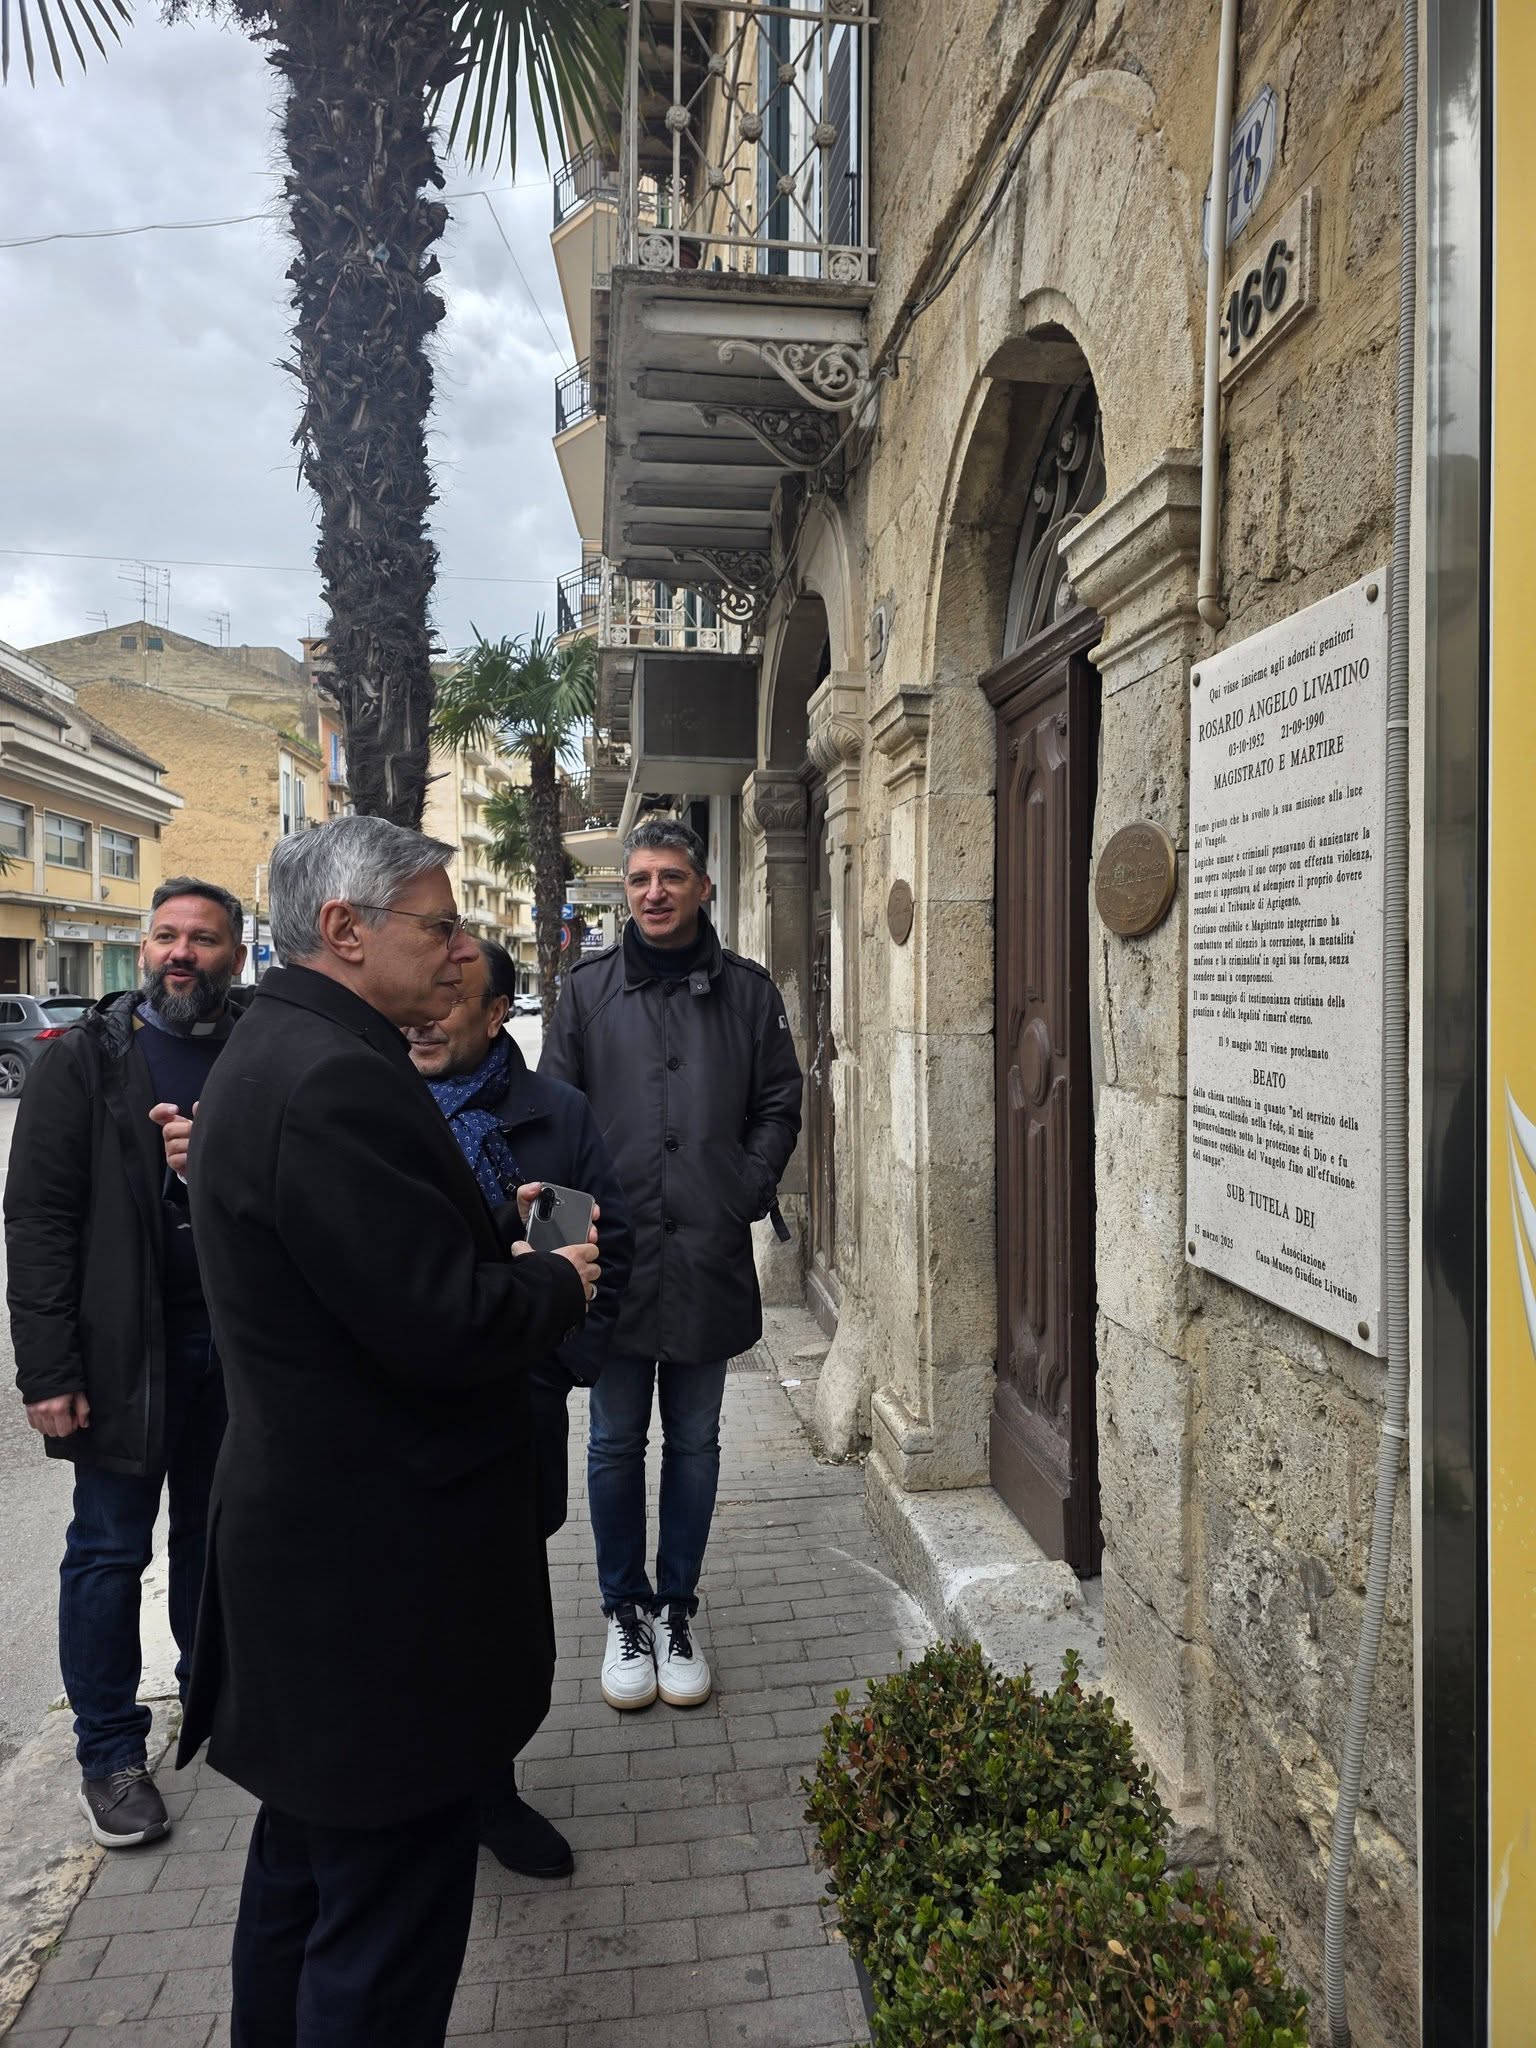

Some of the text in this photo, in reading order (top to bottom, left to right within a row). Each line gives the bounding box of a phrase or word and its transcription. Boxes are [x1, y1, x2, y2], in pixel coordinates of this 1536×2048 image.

[1210, 623, 1354, 703] Qui visse insieme agli adorati genitori
[1199, 657, 1370, 743] ROSARIO ANGELO LIVATINO
[1228, 711, 1325, 757] 03-10-1952 21-09-1990
[1213, 735, 1344, 790] MAGISTRATO E MARTIRE
[1194, 785, 1363, 834] Uomo giusto che ha svolto la sua missione alla luce
[1194, 833, 1228, 850] del Vangelo.
[1194, 856, 1214, 870] Logiche
[1216, 854, 1234, 865] umane
[1242, 845, 1269, 860] criminali
[1272, 841, 1306, 858] pensavano
[1308, 836, 1316, 849] di
[1319, 831, 1360, 847] annientare
[1362, 826, 1370, 840] la
[1194, 849, 1373, 885] sua opera colpendo il suo corpo con efferata violenza,
[1194, 870, 1363, 900] mentre si apprestava ad adempiere il proprio dovere
[1193, 895, 1301, 915] recandosi al Tribunale di Agrigento.
[1193, 923, 1217, 934] Cristiano
[1219, 921, 1243, 933] credibile
[1251, 919, 1285, 933] Magistrato
[1287, 915, 1328, 930] integerrimo
[1331, 914, 1340, 927] ha
[1193, 940, 1223, 950] combattuto
[1225, 938, 1233, 949] nel
[1235, 937, 1258, 949] silenzio
[1260, 936, 1267, 948] la
[1269, 935, 1306, 948] corruzione,
[1309, 934, 1316, 946] la
[1193, 955, 1214, 966] mafiosa
[1221, 954, 1227, 965] la
[1263, 954, 1270, 965] in
[1272, 953, 1287, 968] ogni
[1289, 955, 1301, 965] sua
[1303, 953, 1327, 967] forma,
[1329, 955, 1350, 965] senza
[1193, 971, 1215, 982] scendere
[1217, 971, 1227, 982] mai
[1235, 971, 1274, 985] compromessi.
[1193, 990, 1346, 1008] Il suo messaggio di testimonianza cristiana della
[1192, 1006, 1215, 1018] giustizia
[1221, 1007, 1236, 1019] della
[1289, 1013, 1313, 1025] eterno.
[1218, 1036, 1224, 1047] Il
[1231, 1038, 1252, 1053] maggio
[1254, 1040, 1268, 1053] 2021
[1270, 1042, 1288, 1055] viene
[1290, 1045, 1329, 1060] proclamato
[1252, 1068, 1287, 1090] BEATO
[1192, 1086, 1206, 1099] dalla
[1207, 1089, 1225, 1102] chiesa
[1226, 1095, 1252, 1108] cattolica
[1254, 1098, 1261, 1110] in
[1263, 1103, 1286, 1116] quanto
[1306, 1111, 1336, 1127] servizio
[1339, 1115, 1359, 1131] della
[1192, 1102, 1218, 1119] giustizia,
[1219, 1109, 1249, 1125] eccellendo
[1251, 1116, 1267, 1129] nella
[1269, 1118, 1286, 1136] fede,
[1288, 1123, 1295, 1136] si
[1192, 1119, 1237, 1139] ragionevolmente
[1239, 1131, 1254, 1143] sotto
[1256, 1132, 1263, 1145] la
[1265, 1138, 1300, 1155] protezione
[1302, 1145, 1311, 1159] di
[1313, 1148, 1327, 1163] Dio
[1338, 1153, 1348, 1168] fu
[1192, 1148, 1201, 1160] del
[1192, 1134, 1355, 1190] testimone credibile del Vangelo fino all'effusione
[1226, 1183, 1315, 1229] SUB TUTELA DEI
[1194, 1223, 1234, 1250] 15 marzo 2025
[1281, 1243, 1327, 1271] Associazione
[1255, 1249, 1358, 1304] Casa Museo Giudice Livatino
